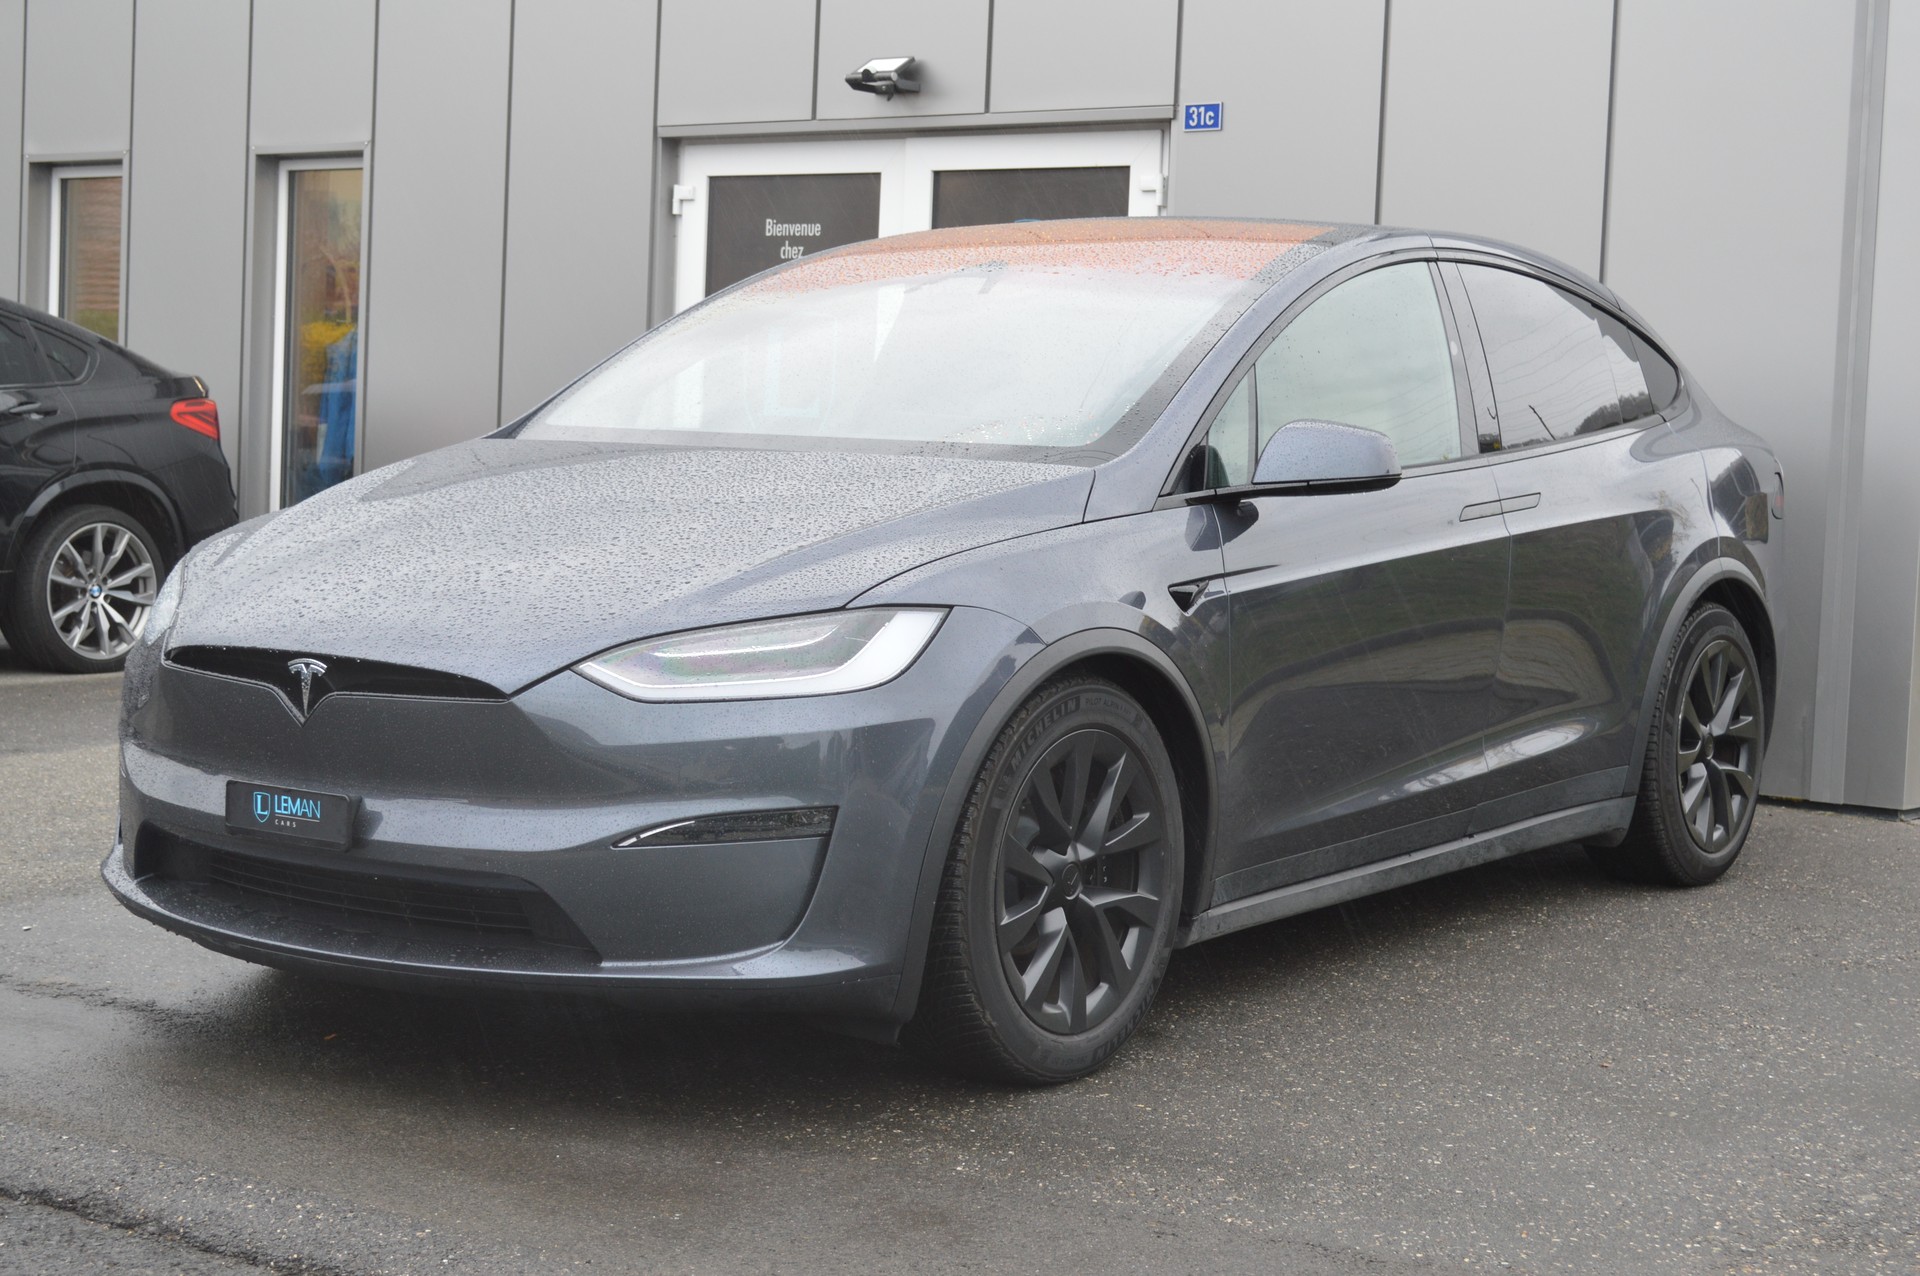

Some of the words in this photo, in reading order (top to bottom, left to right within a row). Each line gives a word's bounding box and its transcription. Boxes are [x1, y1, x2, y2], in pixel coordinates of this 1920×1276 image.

[1189, 106, 1215, 127] 31c
[765, 218, 821, 236] Bienvenue
[780, 240, 804, 259] chez
[1010, 698, 1078, 771] MICHELIN
[275, 794, 320, 819] LEMAN
[275, 819, 297, 828] CARS
